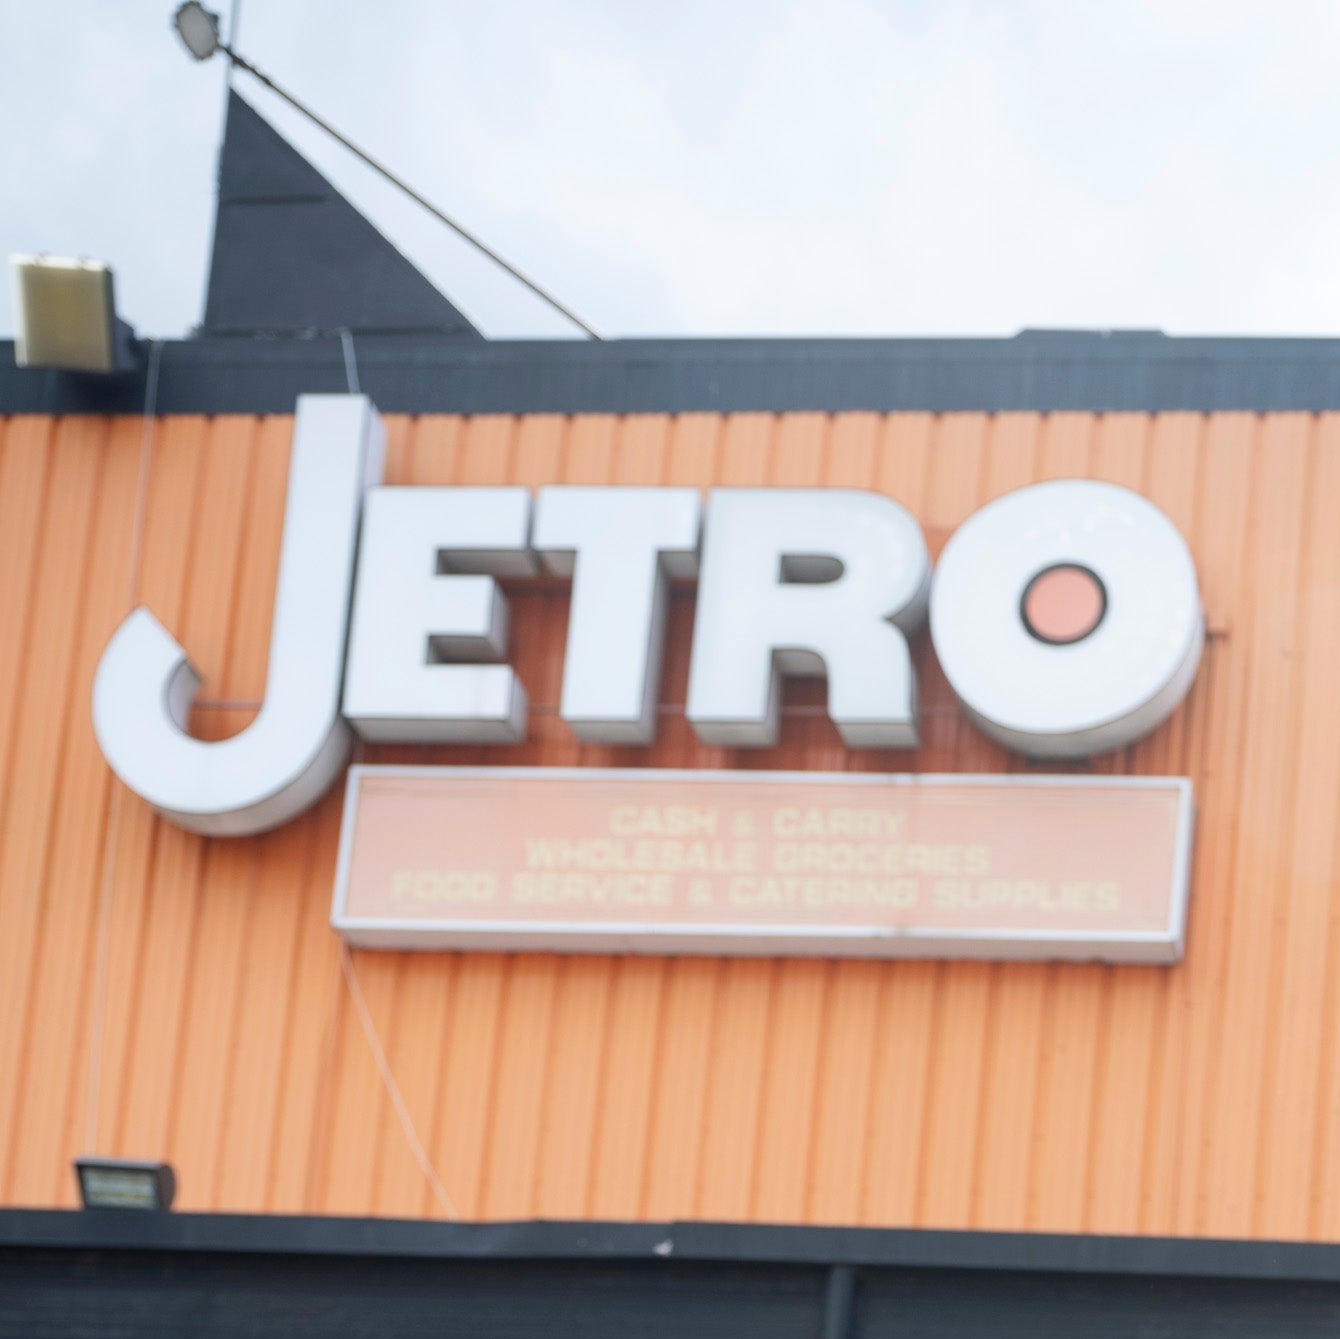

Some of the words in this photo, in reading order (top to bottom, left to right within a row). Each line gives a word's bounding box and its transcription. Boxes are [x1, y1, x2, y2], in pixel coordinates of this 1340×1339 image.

[92, 393, 1204, 836] JETRO
[608, 806, 717, 835] CASH
[771, 807, 906, 837] CARRY
[524, 839, 755, 871] WHOLESALE
[774, 844, 989, 875] GROCERIES
[391, 871, 496, 903] FOOD
[512, 873, 674, 906] SERVICE
[729, 877, 917, 909] CATERING
[932, 881, 1121, 912] SUPPLIES
